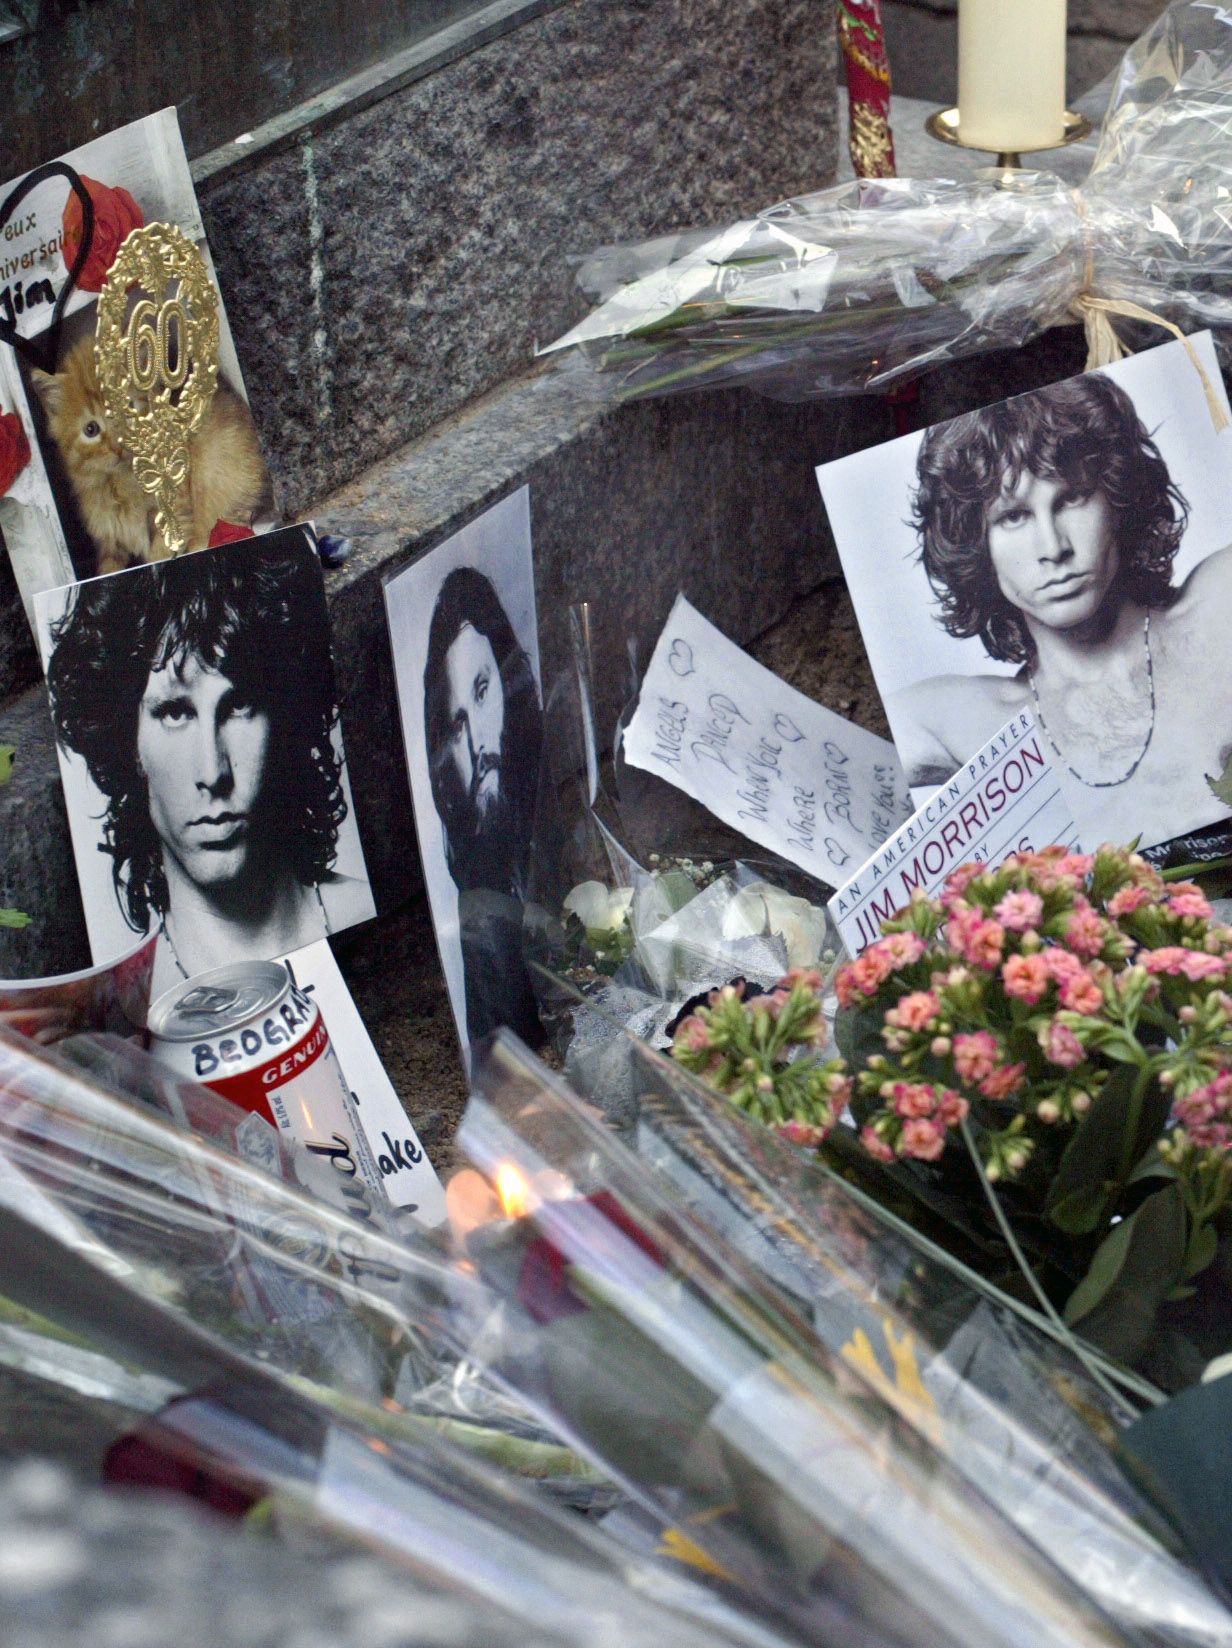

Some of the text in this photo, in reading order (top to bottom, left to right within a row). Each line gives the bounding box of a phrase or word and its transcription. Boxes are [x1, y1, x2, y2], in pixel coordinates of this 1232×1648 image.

[0, 212, 36, 241] eux
[127, 299, 188, 389] 60
[838, 882, 862, 914] AN
[872, 782, 961, 880] AMERICAN
[969, 714, 1030, 781] PRAYER
[855, 887, 897, 954] JIM
[900, 738, 1046, 897] MORRISON
[377, 1131, 423, 1179] ake
